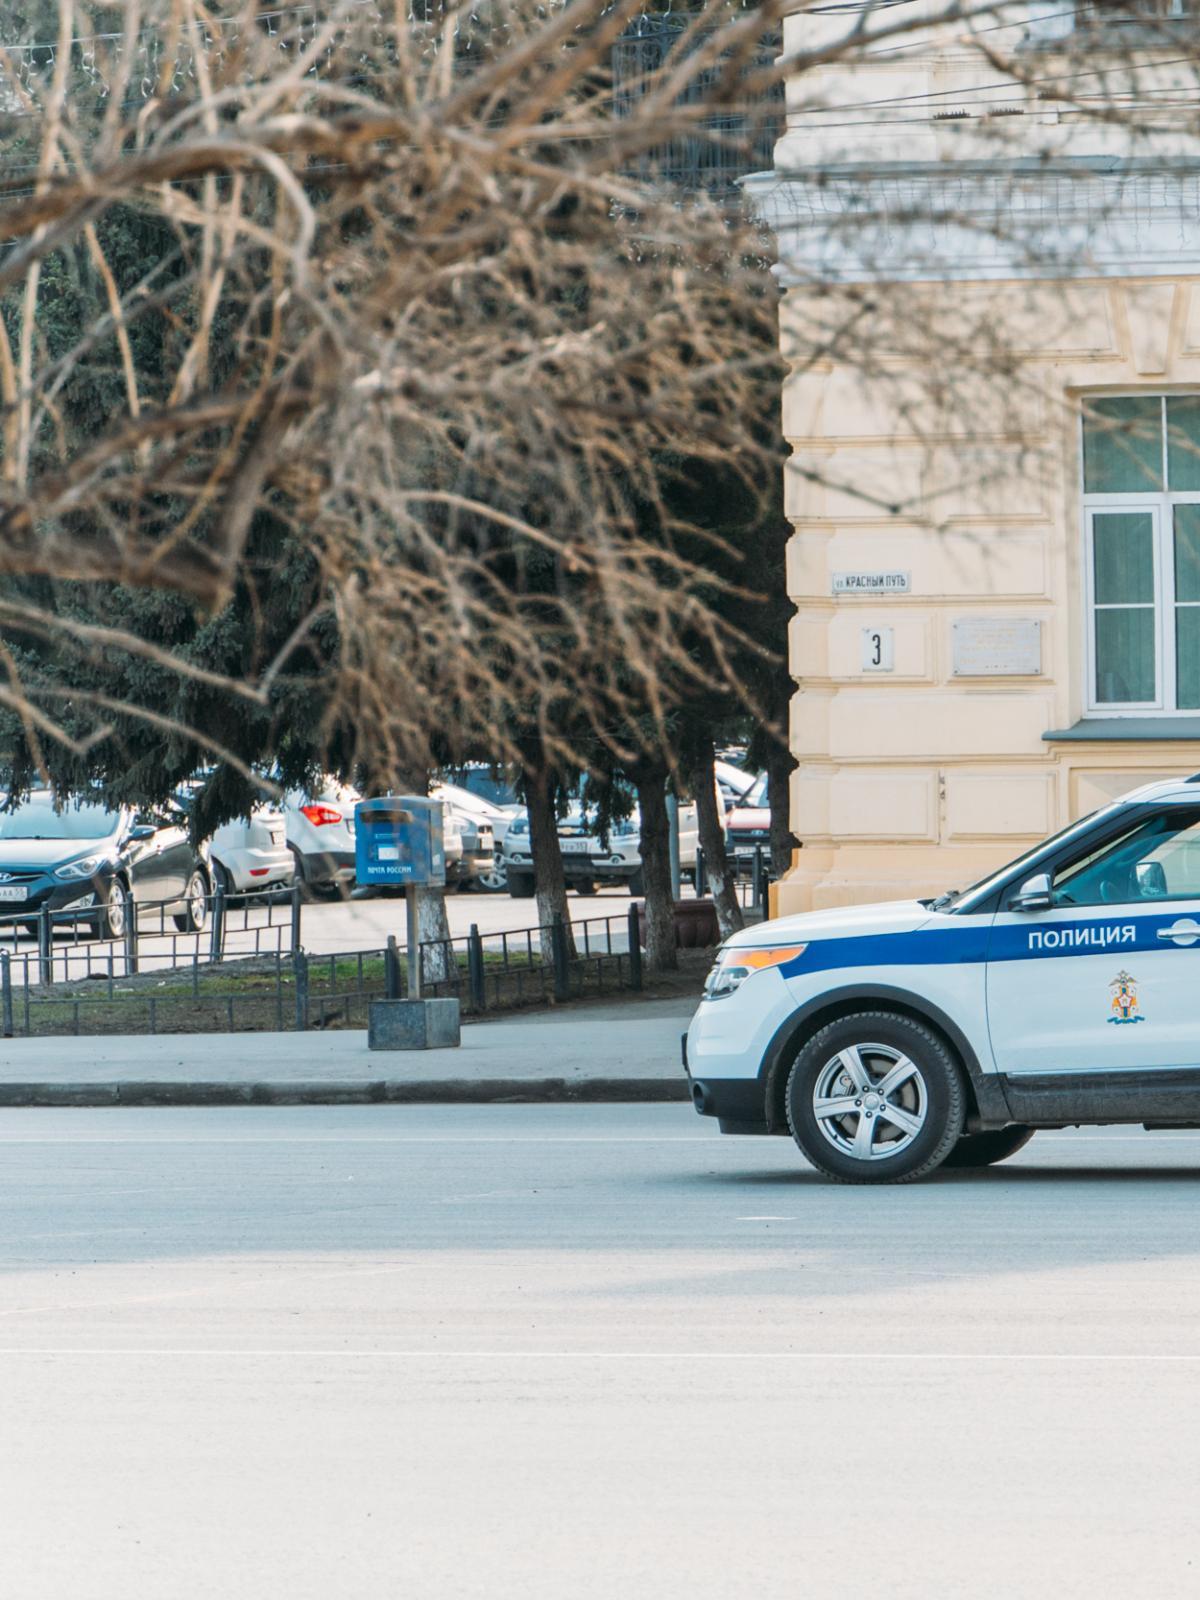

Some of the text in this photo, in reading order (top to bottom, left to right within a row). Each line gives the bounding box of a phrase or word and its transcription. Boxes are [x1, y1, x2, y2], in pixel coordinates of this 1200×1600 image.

[846, 575, 884, 587] КРАСНЫЙ
[886, 574, 906, 587] ПУТЬ
[872, 634, 881, 665] 3
[368, 866, 412, 874] ПОЧТА РОССИИ
[1029, 925, 1136, 949] ПОЛИЦИЯ
